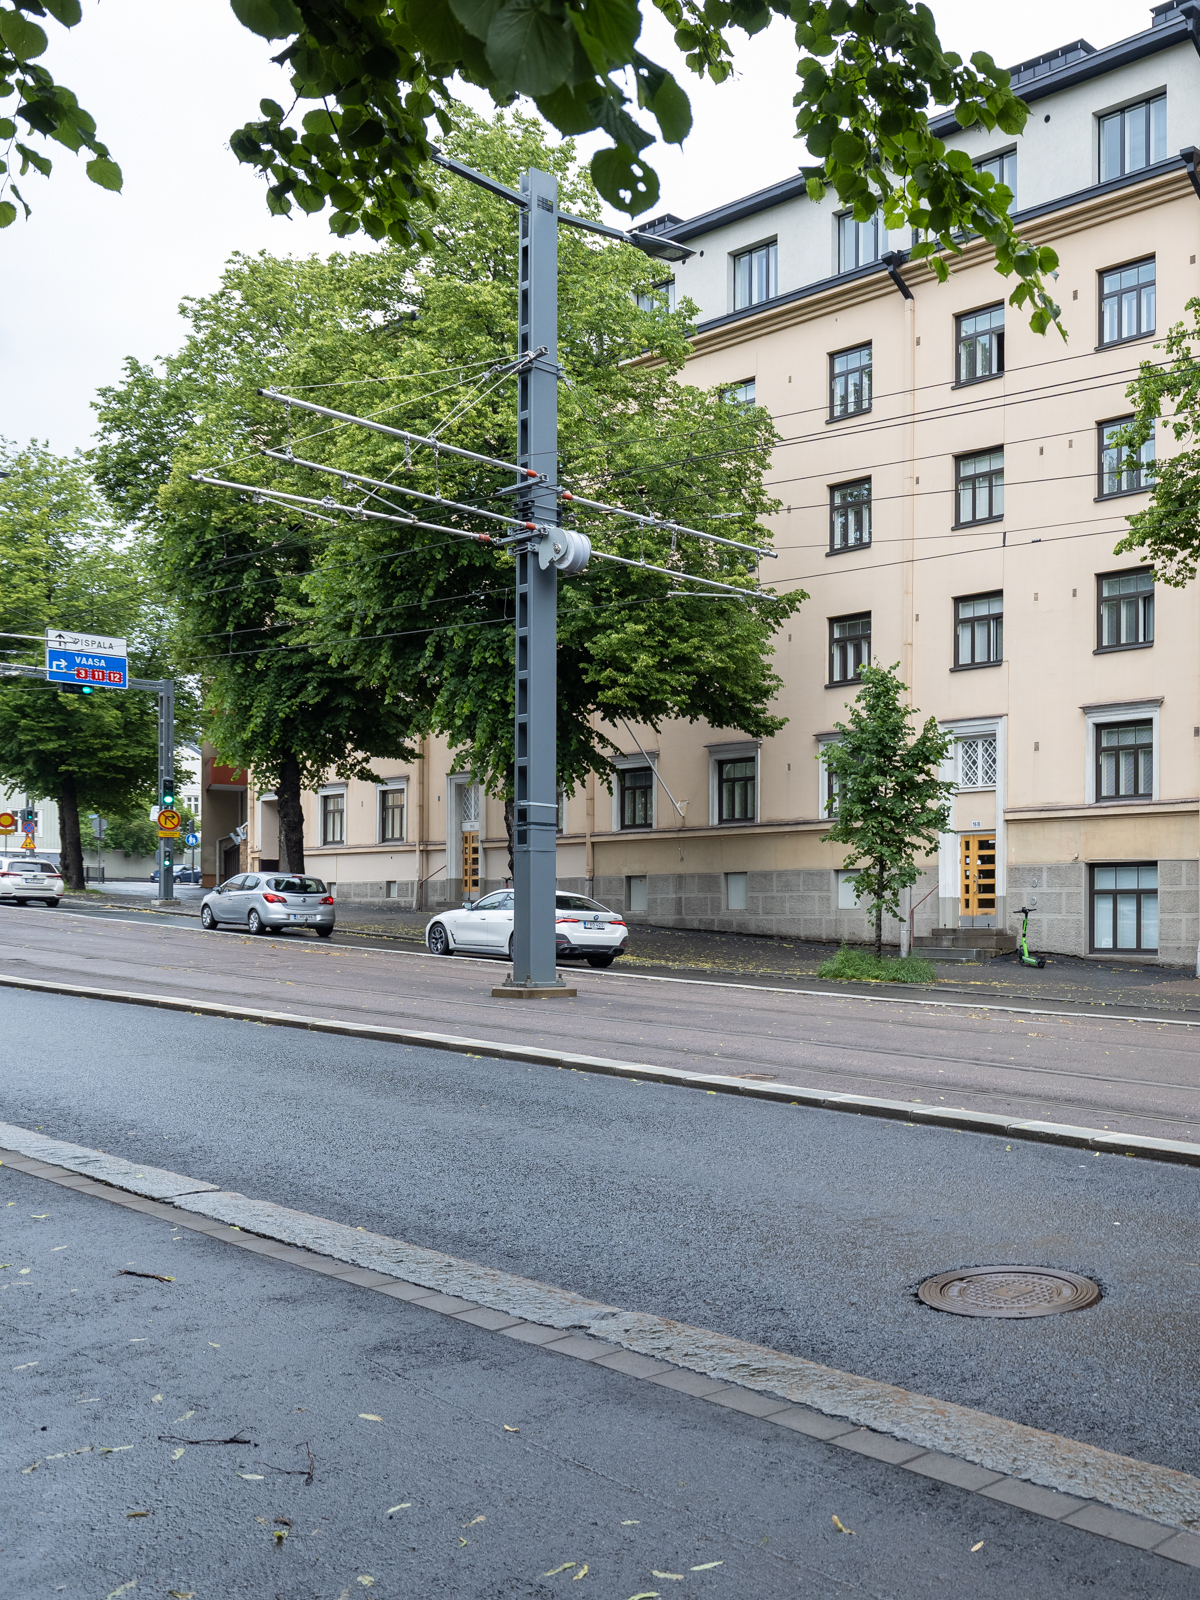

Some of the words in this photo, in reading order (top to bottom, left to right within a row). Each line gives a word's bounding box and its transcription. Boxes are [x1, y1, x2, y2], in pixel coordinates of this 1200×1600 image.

[74, 655, 106, 667] VAASA
[79, 669, 86, 678] 3
[94, 671, 103, 680] 11
[110, 673, 121, 682] 12
